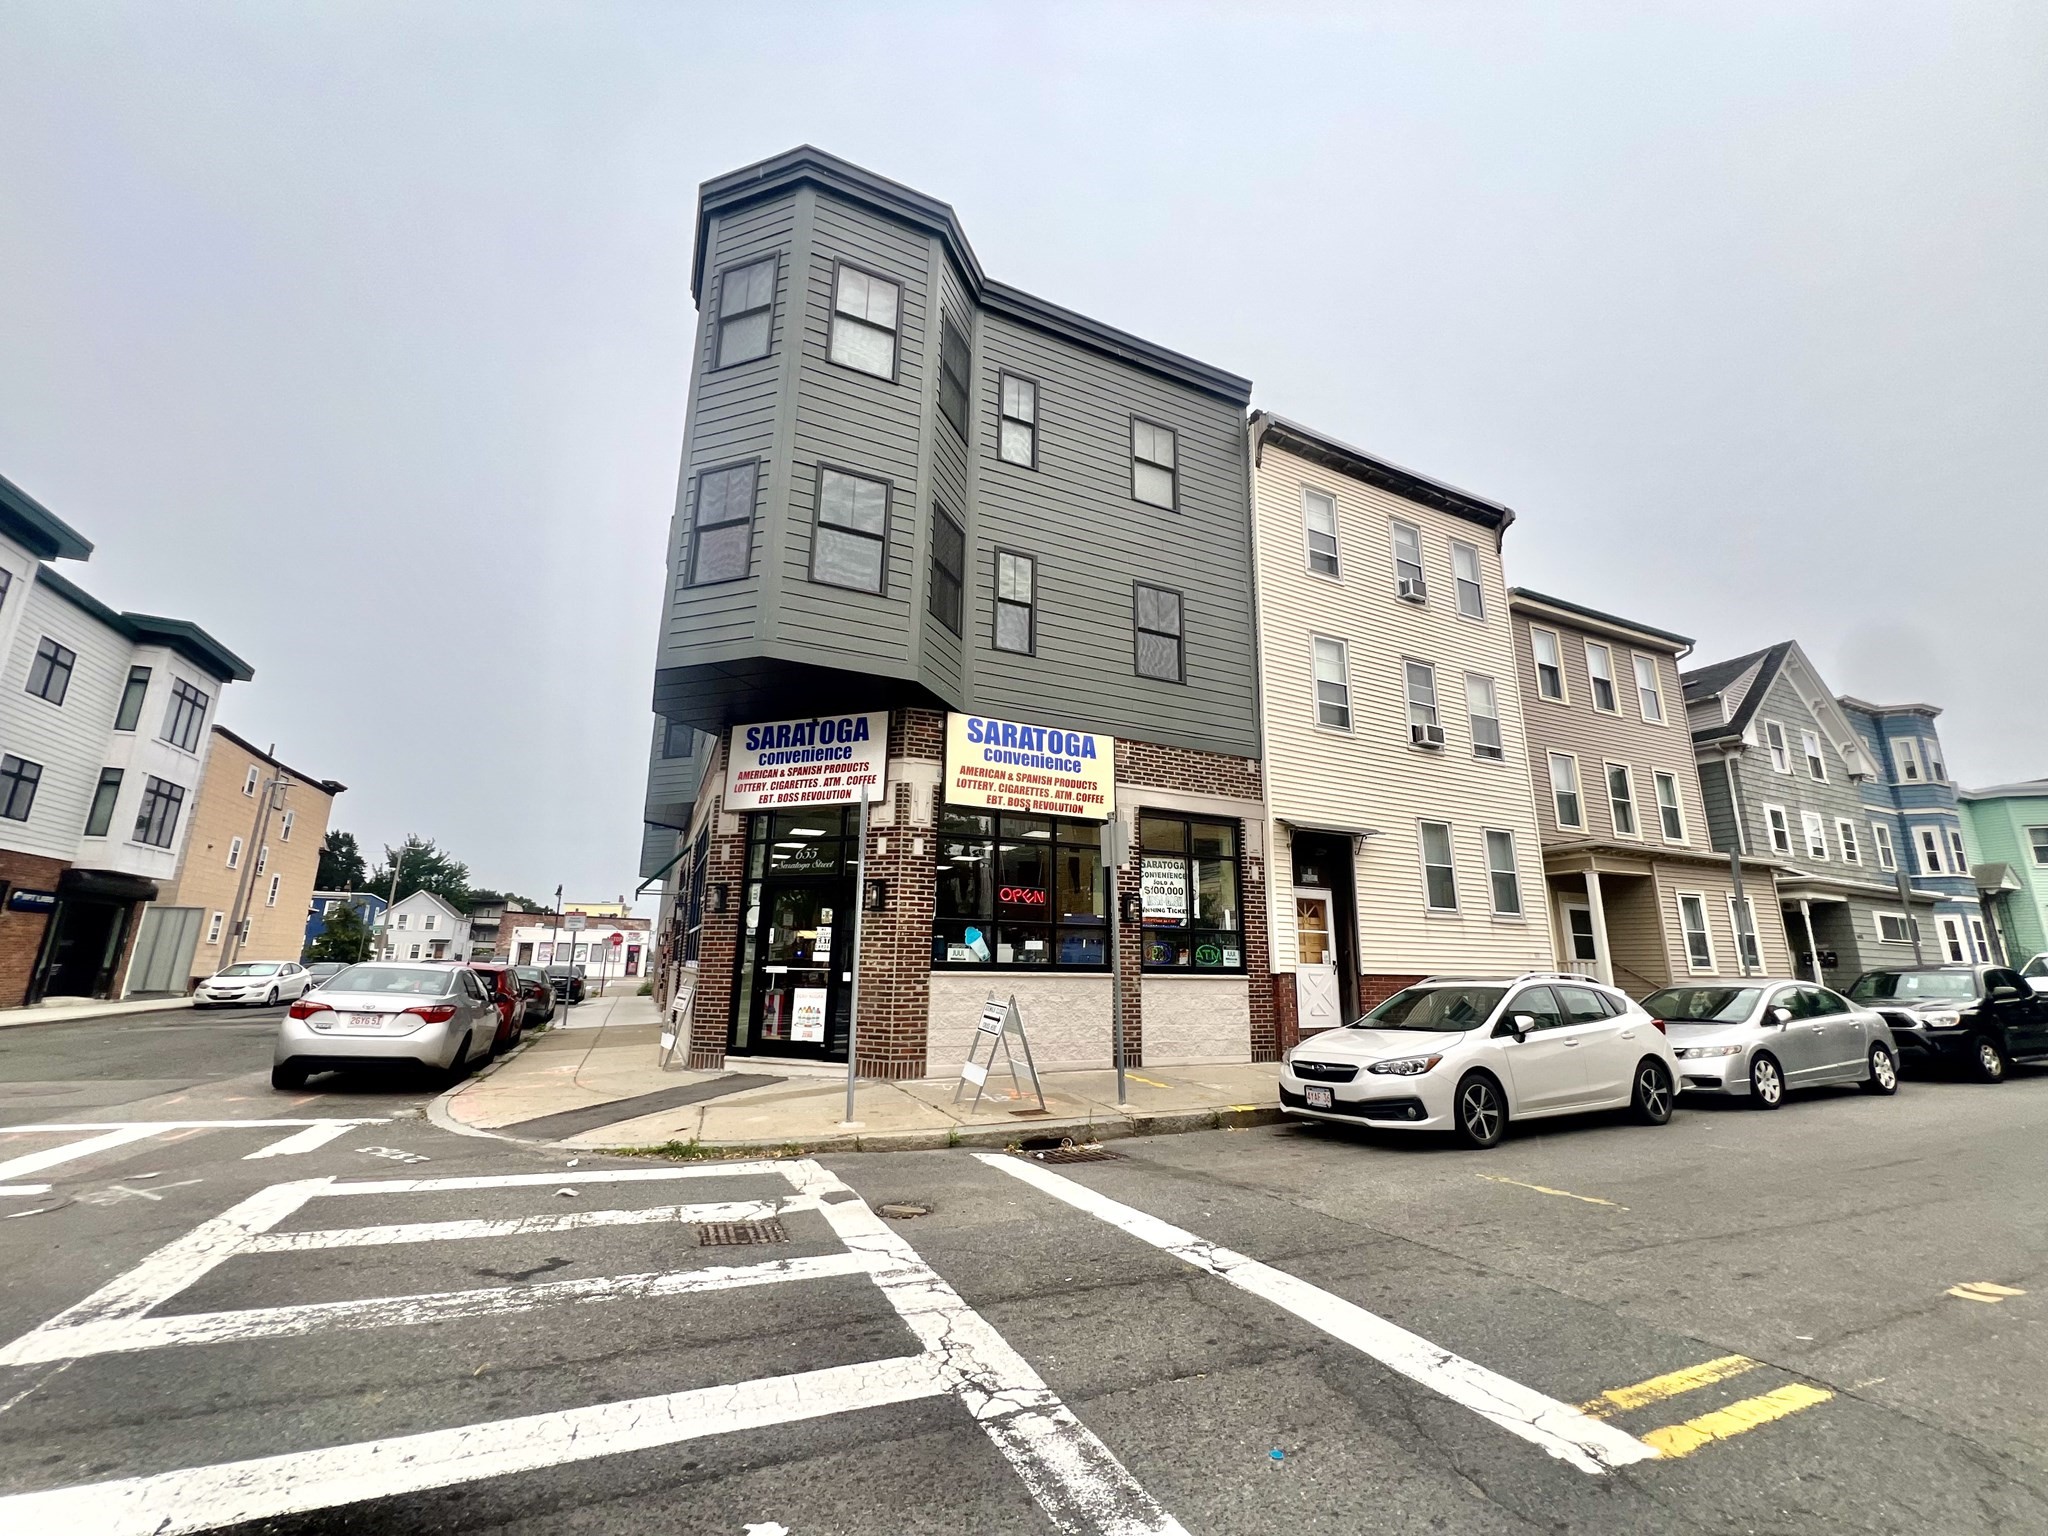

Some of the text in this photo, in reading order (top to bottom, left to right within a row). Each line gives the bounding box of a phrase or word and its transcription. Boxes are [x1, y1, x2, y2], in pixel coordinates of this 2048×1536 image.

[746, 717, 869, 751] SARATOGA
[967, 717, 1097, 760] SARATOGA
[758, 745, 852, 766] convenience
[984, 747, 1082, 773] convenience
[737, 762, 870, 780] AMERICAN & SPANISH PRODUCTS
[959, 765, 1098, 791] AMERICAN & SPANISH PRODUCTS
[846, 774, 877, 786] COFFEE
[777, 792, 799, 803] BOSS
[801, 789, 852, 801] REVOLUTION
[1076, 792, 1105, 804] COFFEE
[1007, 797, 1031, 809] BOSS
[1032, 799, 1084, 814] REVOLUTION
[795, 847, 819, 860] 655
[778, 859, 835, 871] Saratoga Street
[1141, 859, 1185, 870] SARATOGA
[1000, 887, 1044, 903] OPEN
[1196, 949, 1220, 961] ATM
